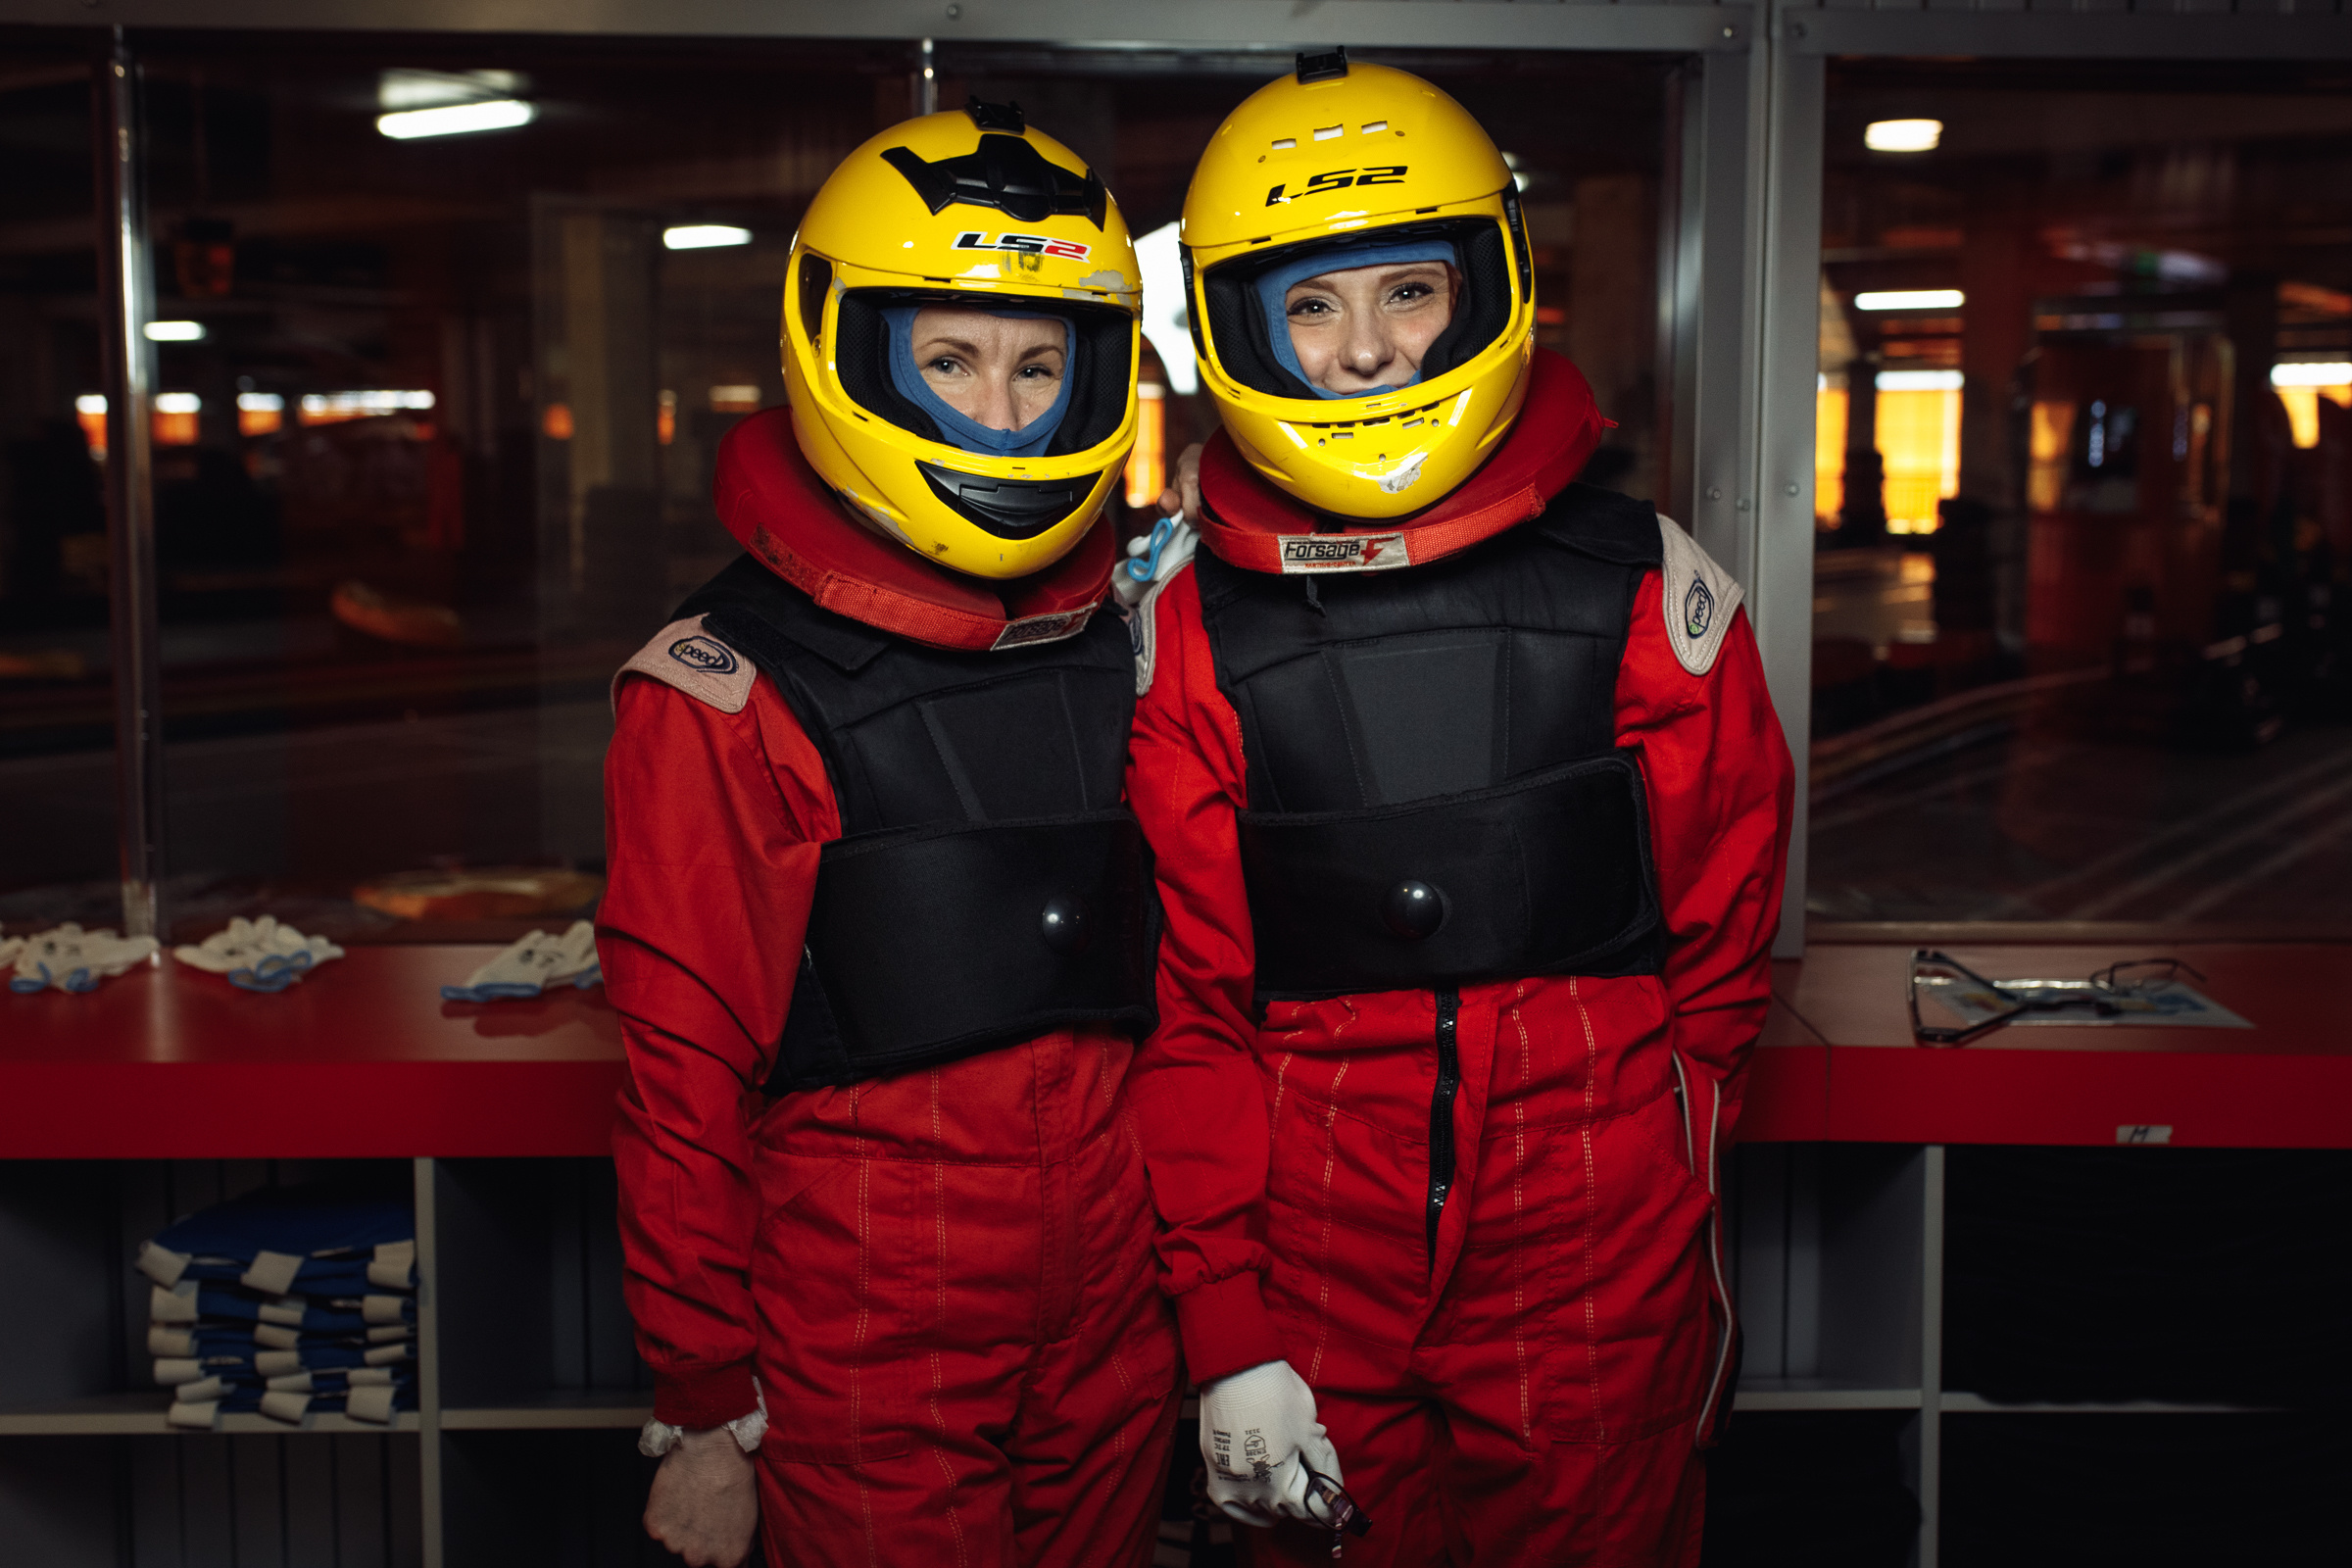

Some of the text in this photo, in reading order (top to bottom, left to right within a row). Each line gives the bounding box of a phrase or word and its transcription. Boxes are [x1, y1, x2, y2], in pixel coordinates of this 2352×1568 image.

[1265, 166, 1408, 207] LS2
[955, 232, 1089, 262] LS2
[1285, 541, 1361, 561] Forsage
